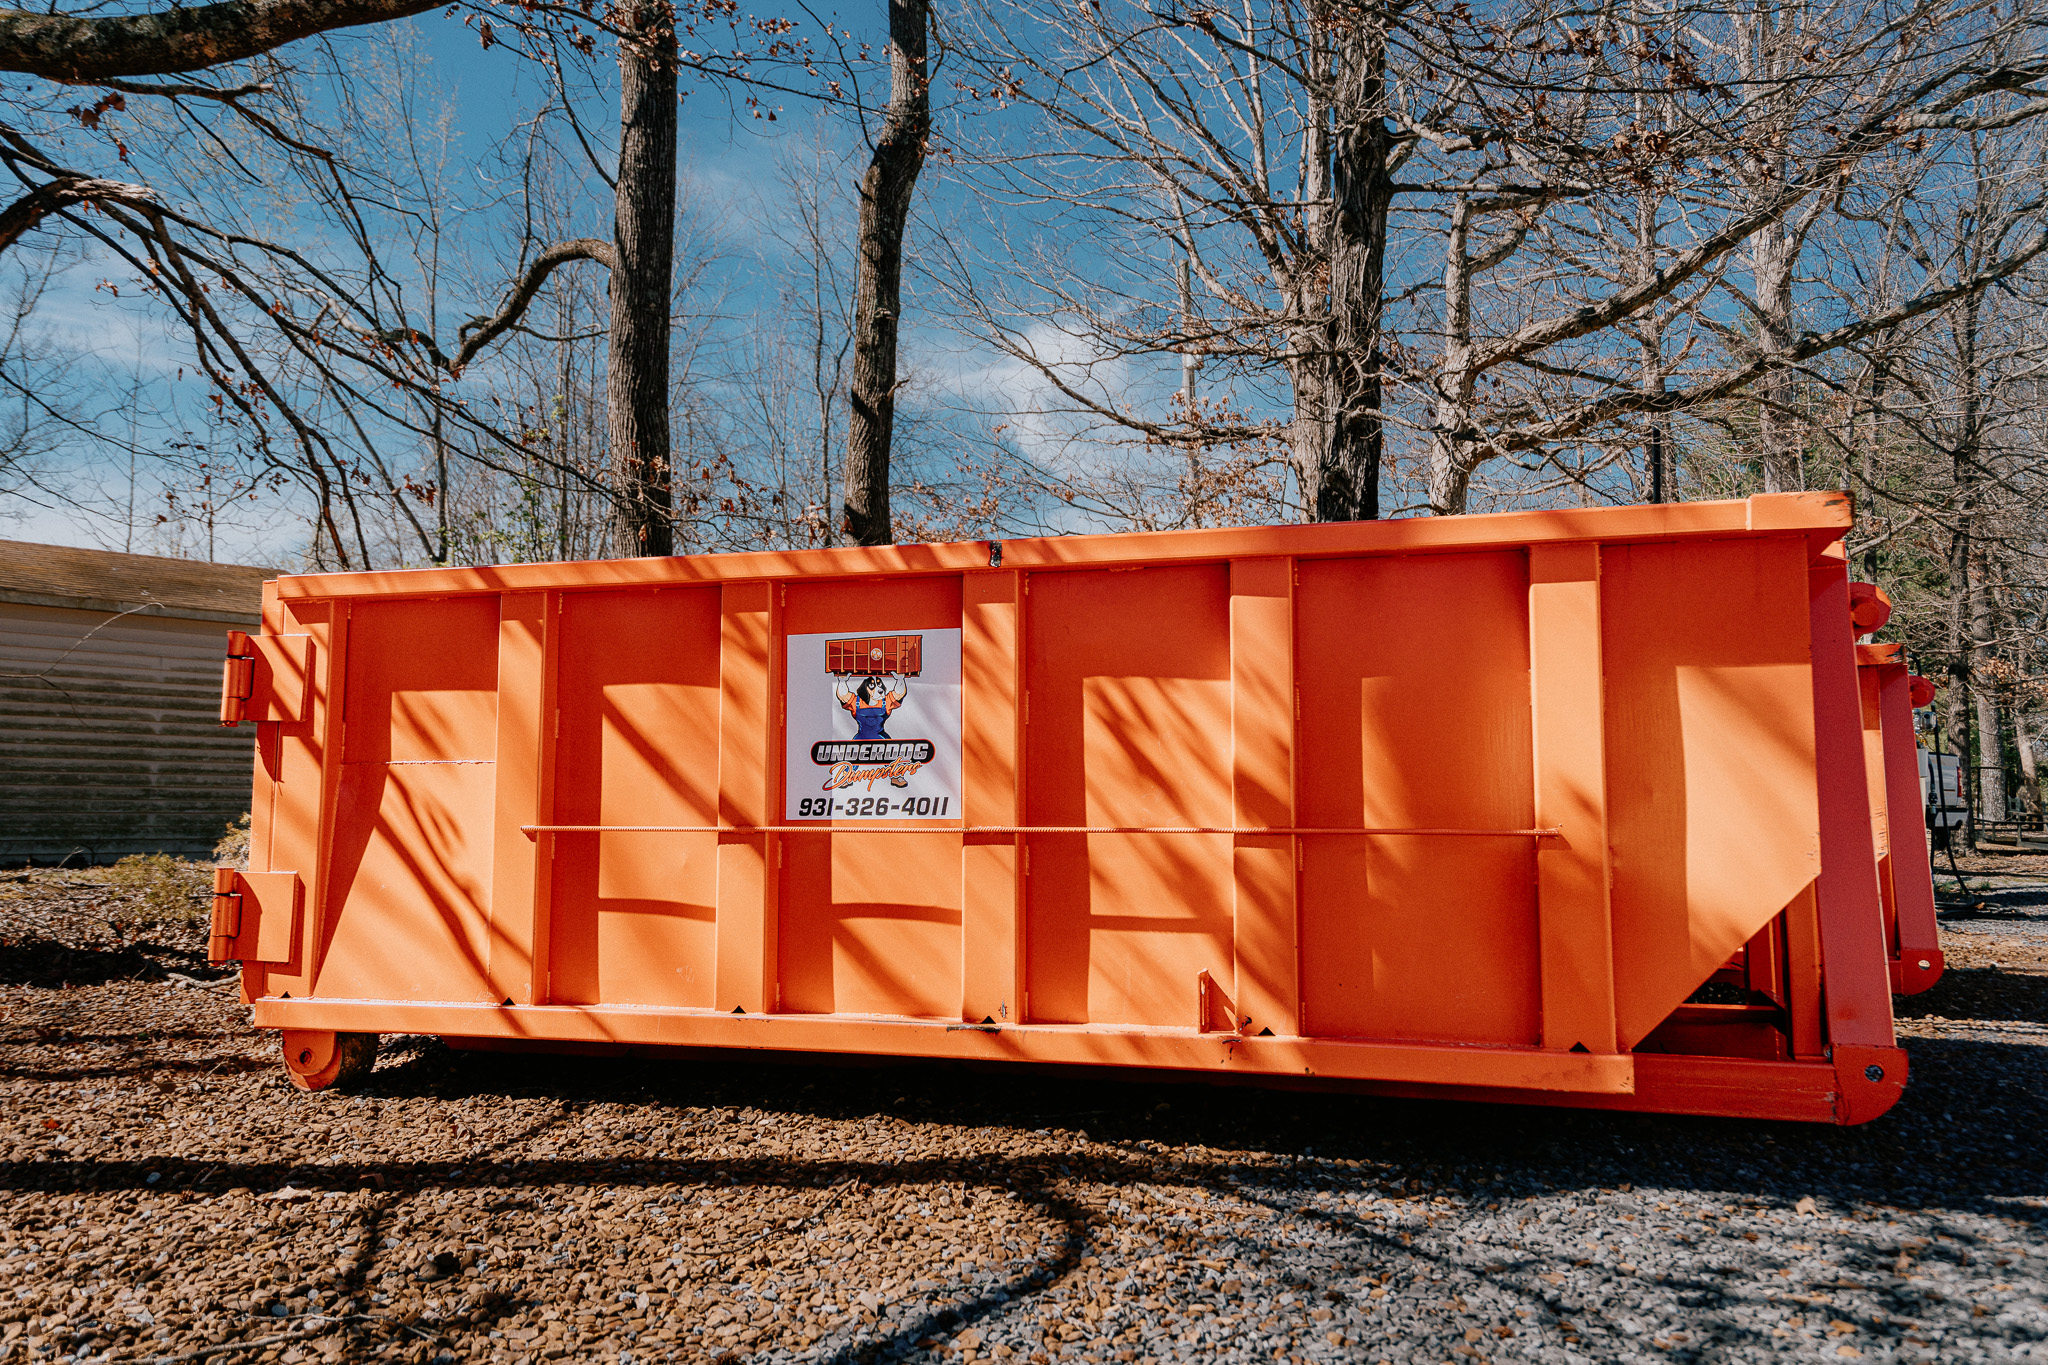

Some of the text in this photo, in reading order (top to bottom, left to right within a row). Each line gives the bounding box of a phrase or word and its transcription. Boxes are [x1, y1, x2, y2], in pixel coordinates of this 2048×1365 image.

[816, 743, 929, 762] UNDERDOG
[822, 757, 923, 792] Dumpsters
[798, 796, 949, 817] 931-326-4011
